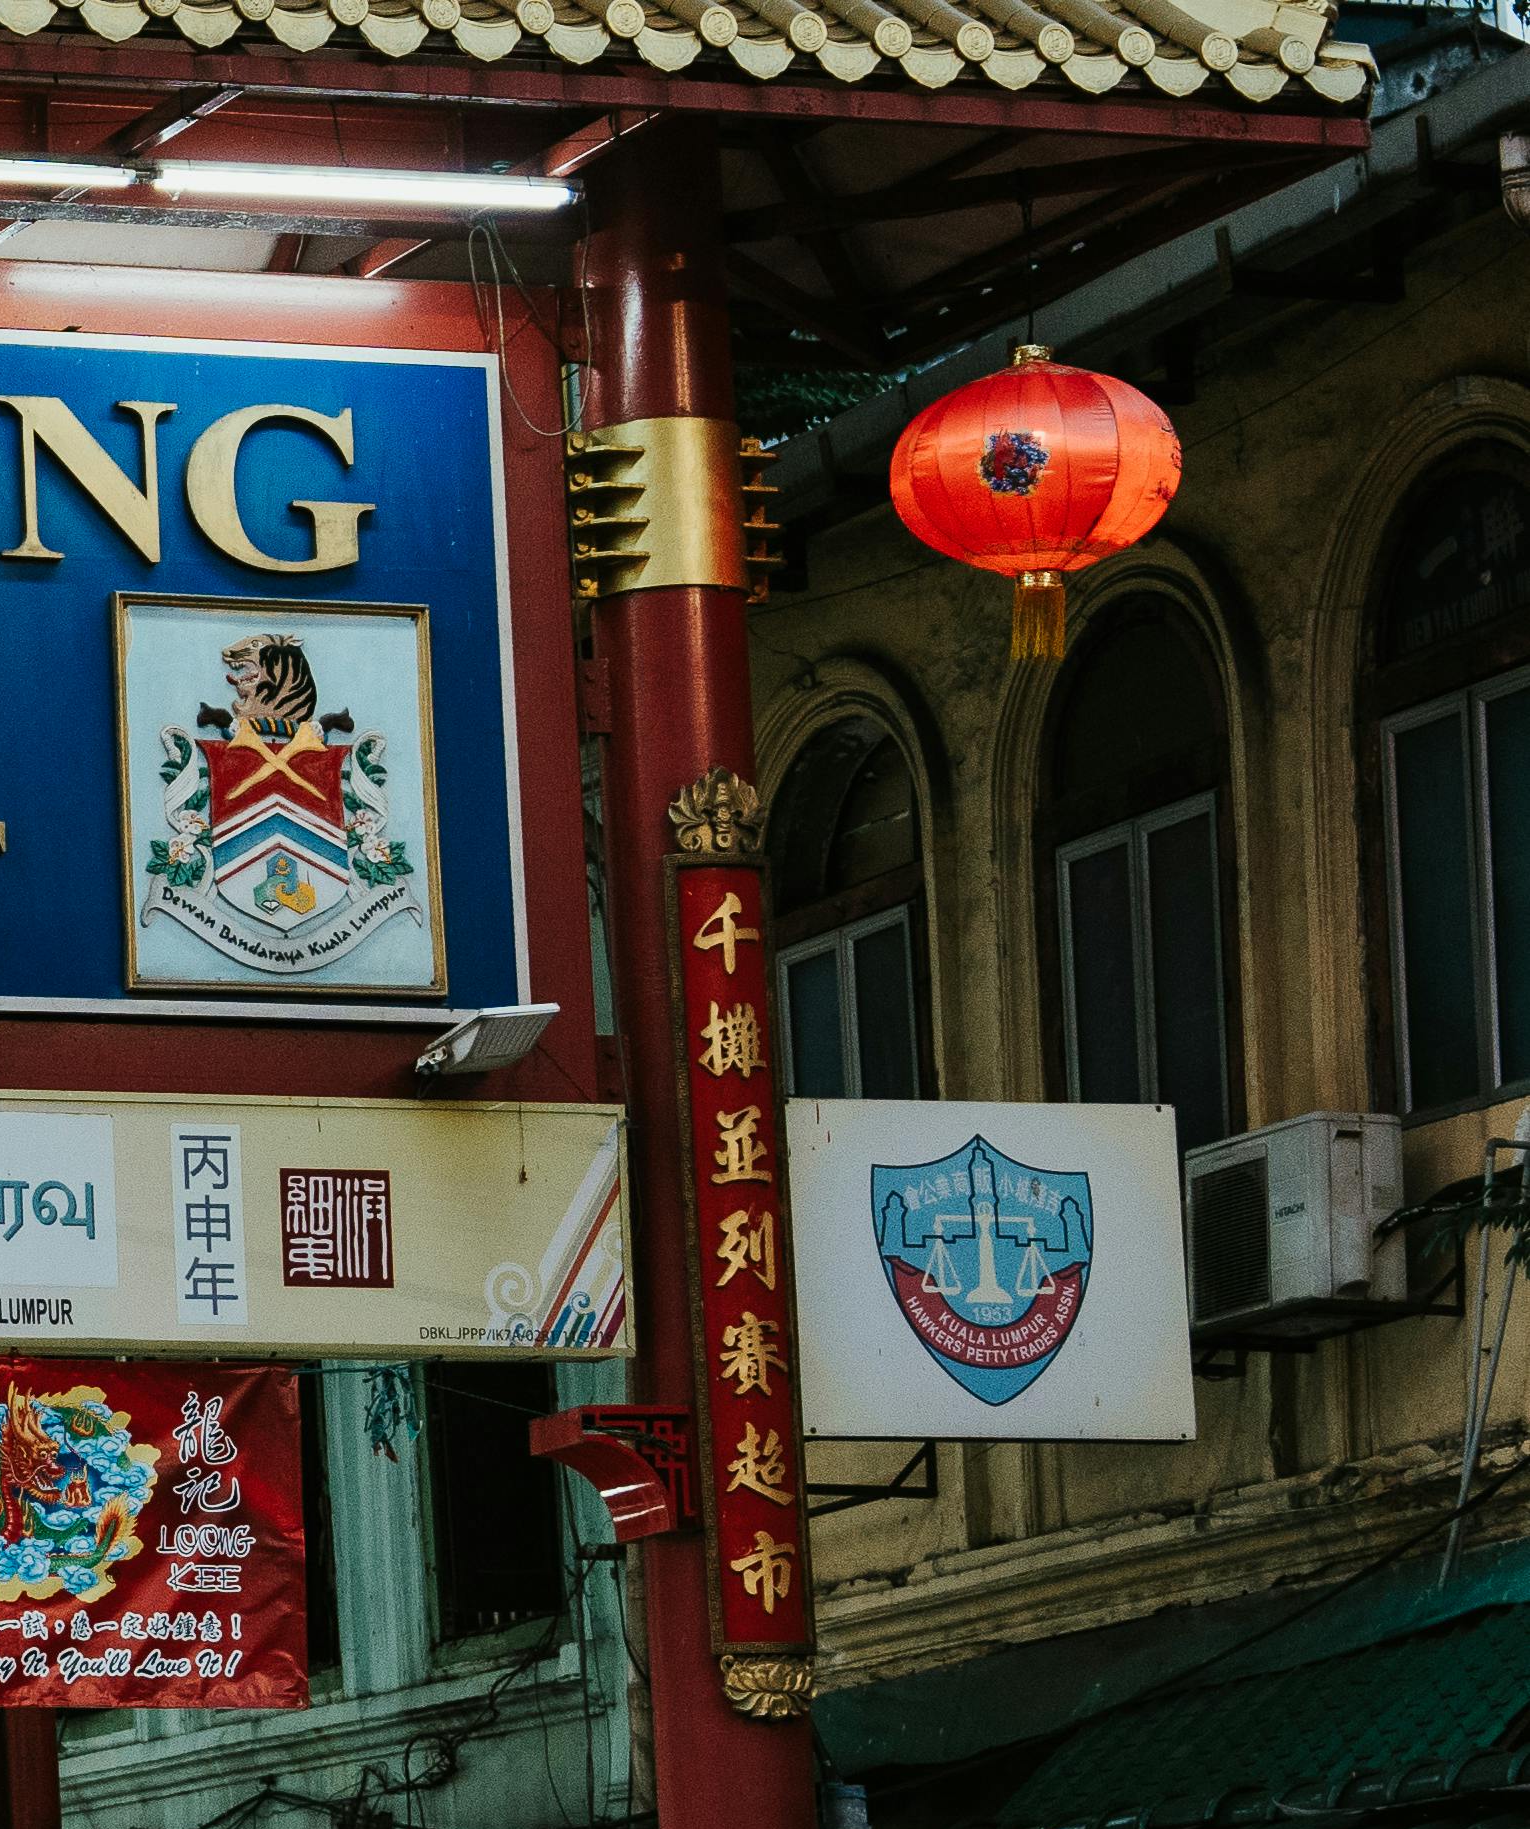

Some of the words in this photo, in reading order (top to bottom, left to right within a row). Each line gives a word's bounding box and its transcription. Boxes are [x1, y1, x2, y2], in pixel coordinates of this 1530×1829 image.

[162, 886, 217, 930] Dewan
[218, 924, 305, 966] Bandaraya
[308, 929, 352, 957] Kuala
[350, 886, 407, 931] Lumpur
[179, 1133, 240, 1317] 丙申年
[172, 1390, 241, 1516] 龍記
[155, 1522, 256, 1559] LOONG
[166, 1561, 243, 1595] KEE
[58, 1647, 132, 1686] You'll
[134, 1648, 191, 1677] Love
